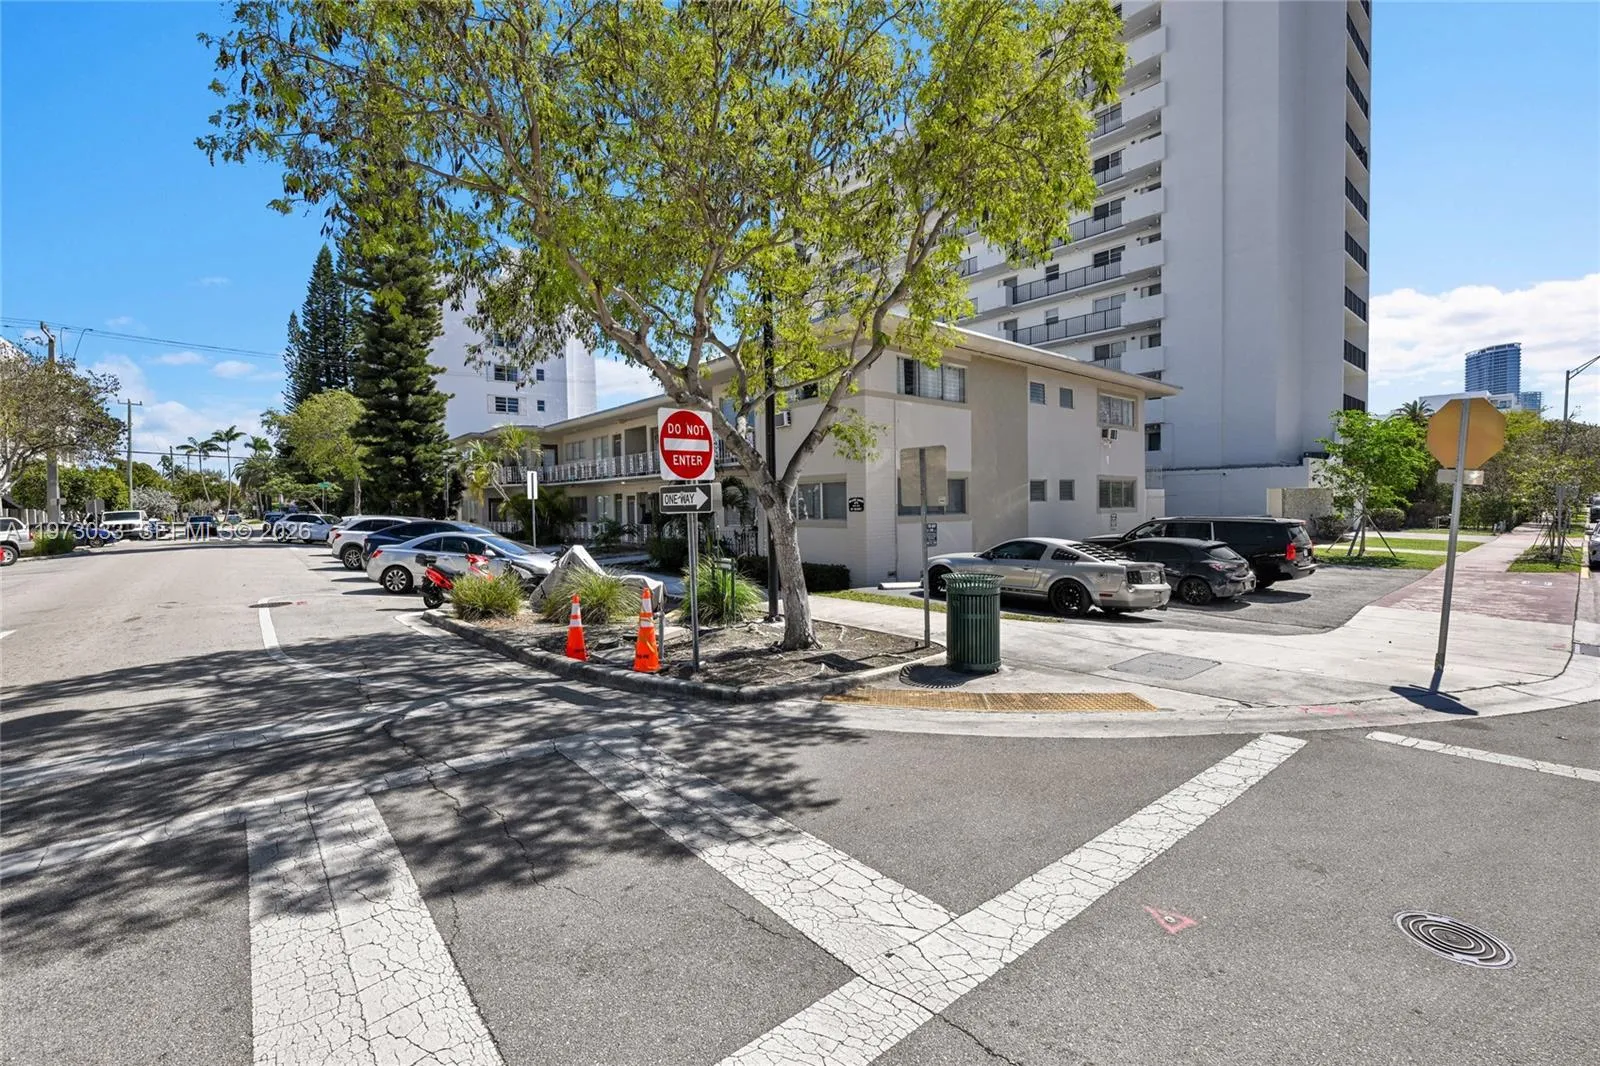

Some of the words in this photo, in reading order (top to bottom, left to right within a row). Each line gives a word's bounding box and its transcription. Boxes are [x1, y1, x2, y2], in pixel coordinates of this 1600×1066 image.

[667, 423, 681, 435] DO
[686, 424, 705, 436] NOT
[672, 454, 703, 466] ENTER
[664, 494, 679, 504] ONE
[680, 493, 695, 504] WAY
